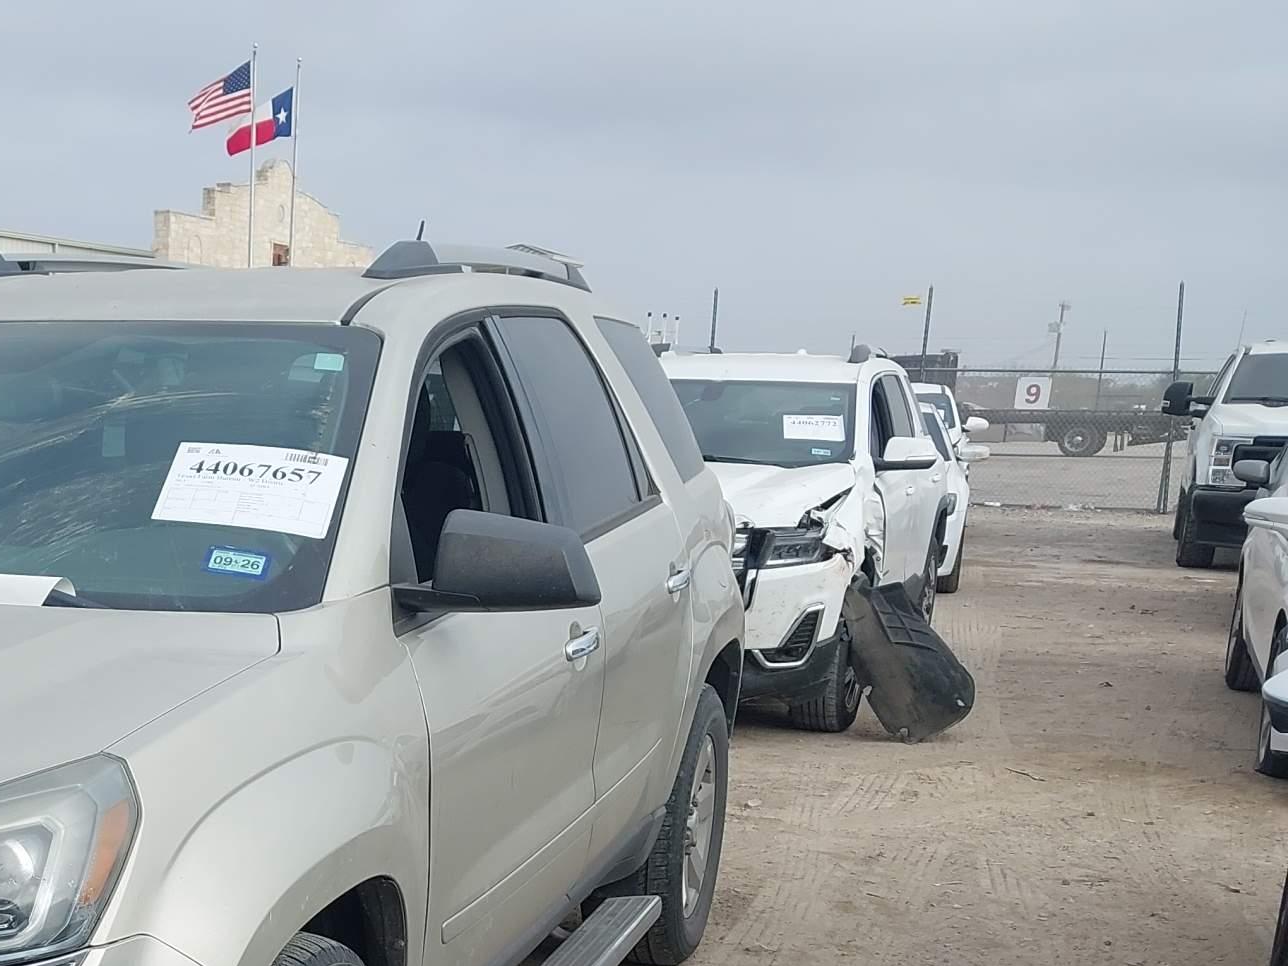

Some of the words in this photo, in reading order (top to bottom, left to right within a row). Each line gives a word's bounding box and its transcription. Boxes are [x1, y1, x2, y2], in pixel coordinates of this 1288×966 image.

[1024, 383, 1041, 405] 9
[189, 459, 323, 485] 44067657
[213, 555, 232, 566] 09
[240, 559, 260, 570] 26
